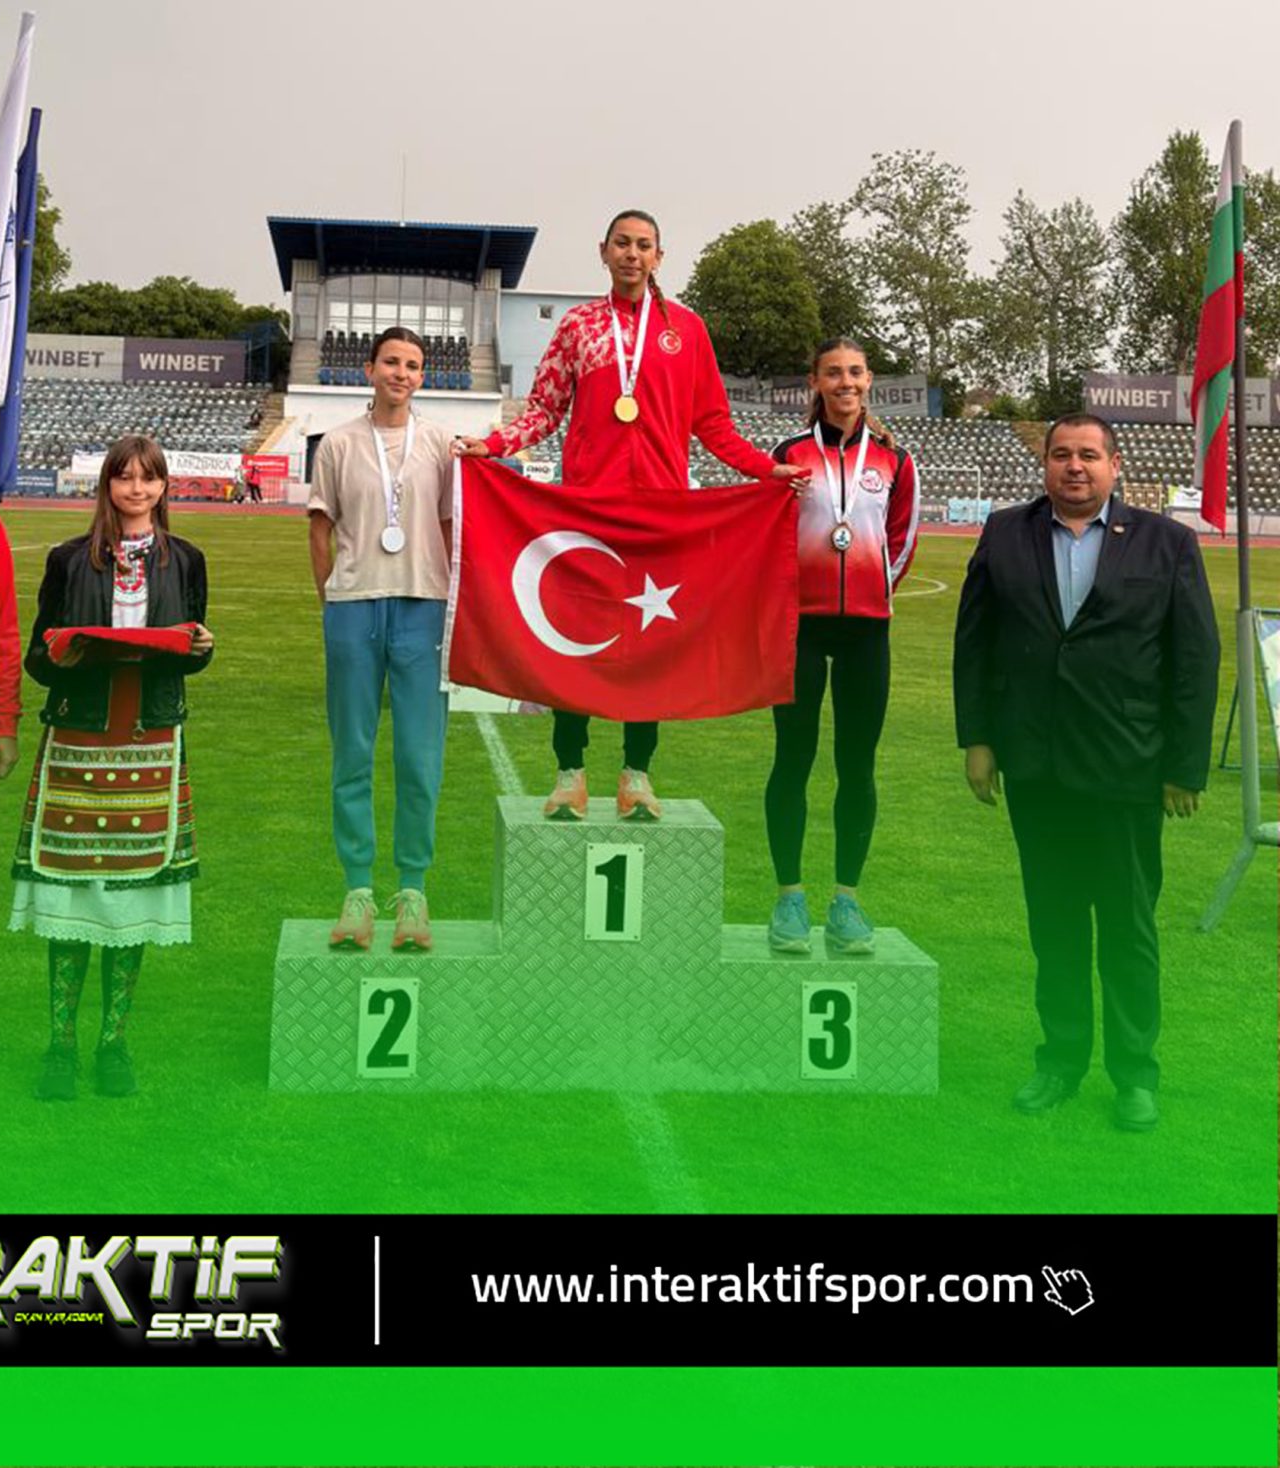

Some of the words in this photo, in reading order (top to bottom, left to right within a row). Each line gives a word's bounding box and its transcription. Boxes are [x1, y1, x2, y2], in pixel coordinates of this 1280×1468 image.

[139, 353, 225, 373] WINBET
[1089, 388, 1172, 409] WINBET
[594, 853, 628, 932] 1
[366, 987, 412, 1068] 2
[807, 988, 852, 1070] 3
